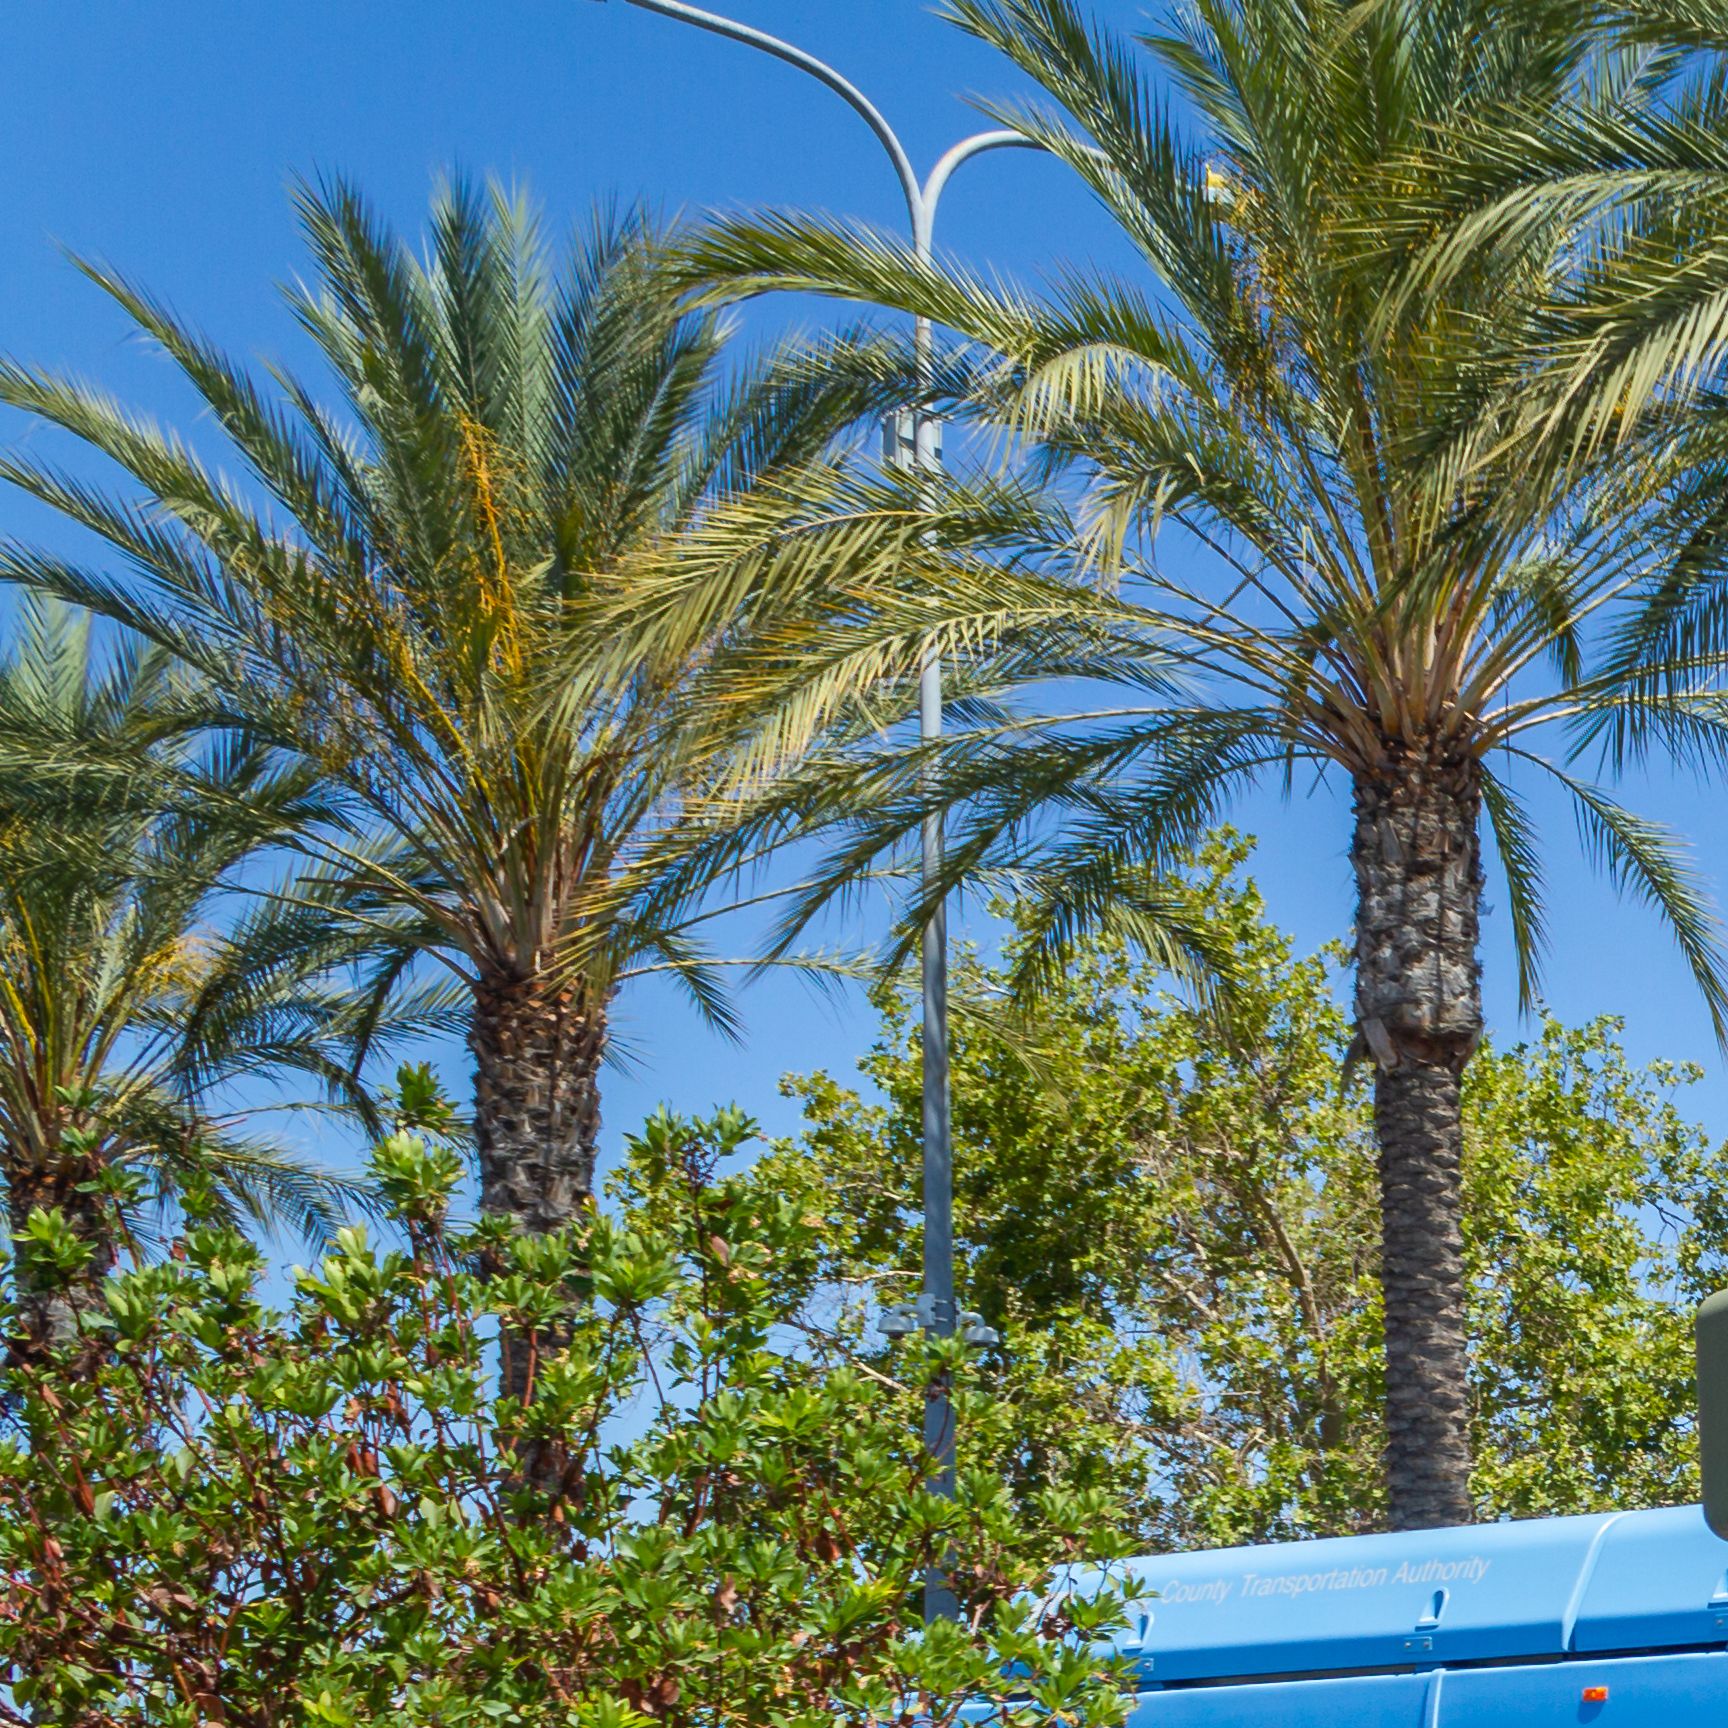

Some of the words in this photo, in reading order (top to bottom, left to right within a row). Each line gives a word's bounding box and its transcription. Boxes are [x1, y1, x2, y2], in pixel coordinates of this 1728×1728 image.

[1161, 1579, 1232, 1604] County
[1240, 1567, 1388, 1597] Transportation
[1392, 1556, 1491, 1584] Authority
